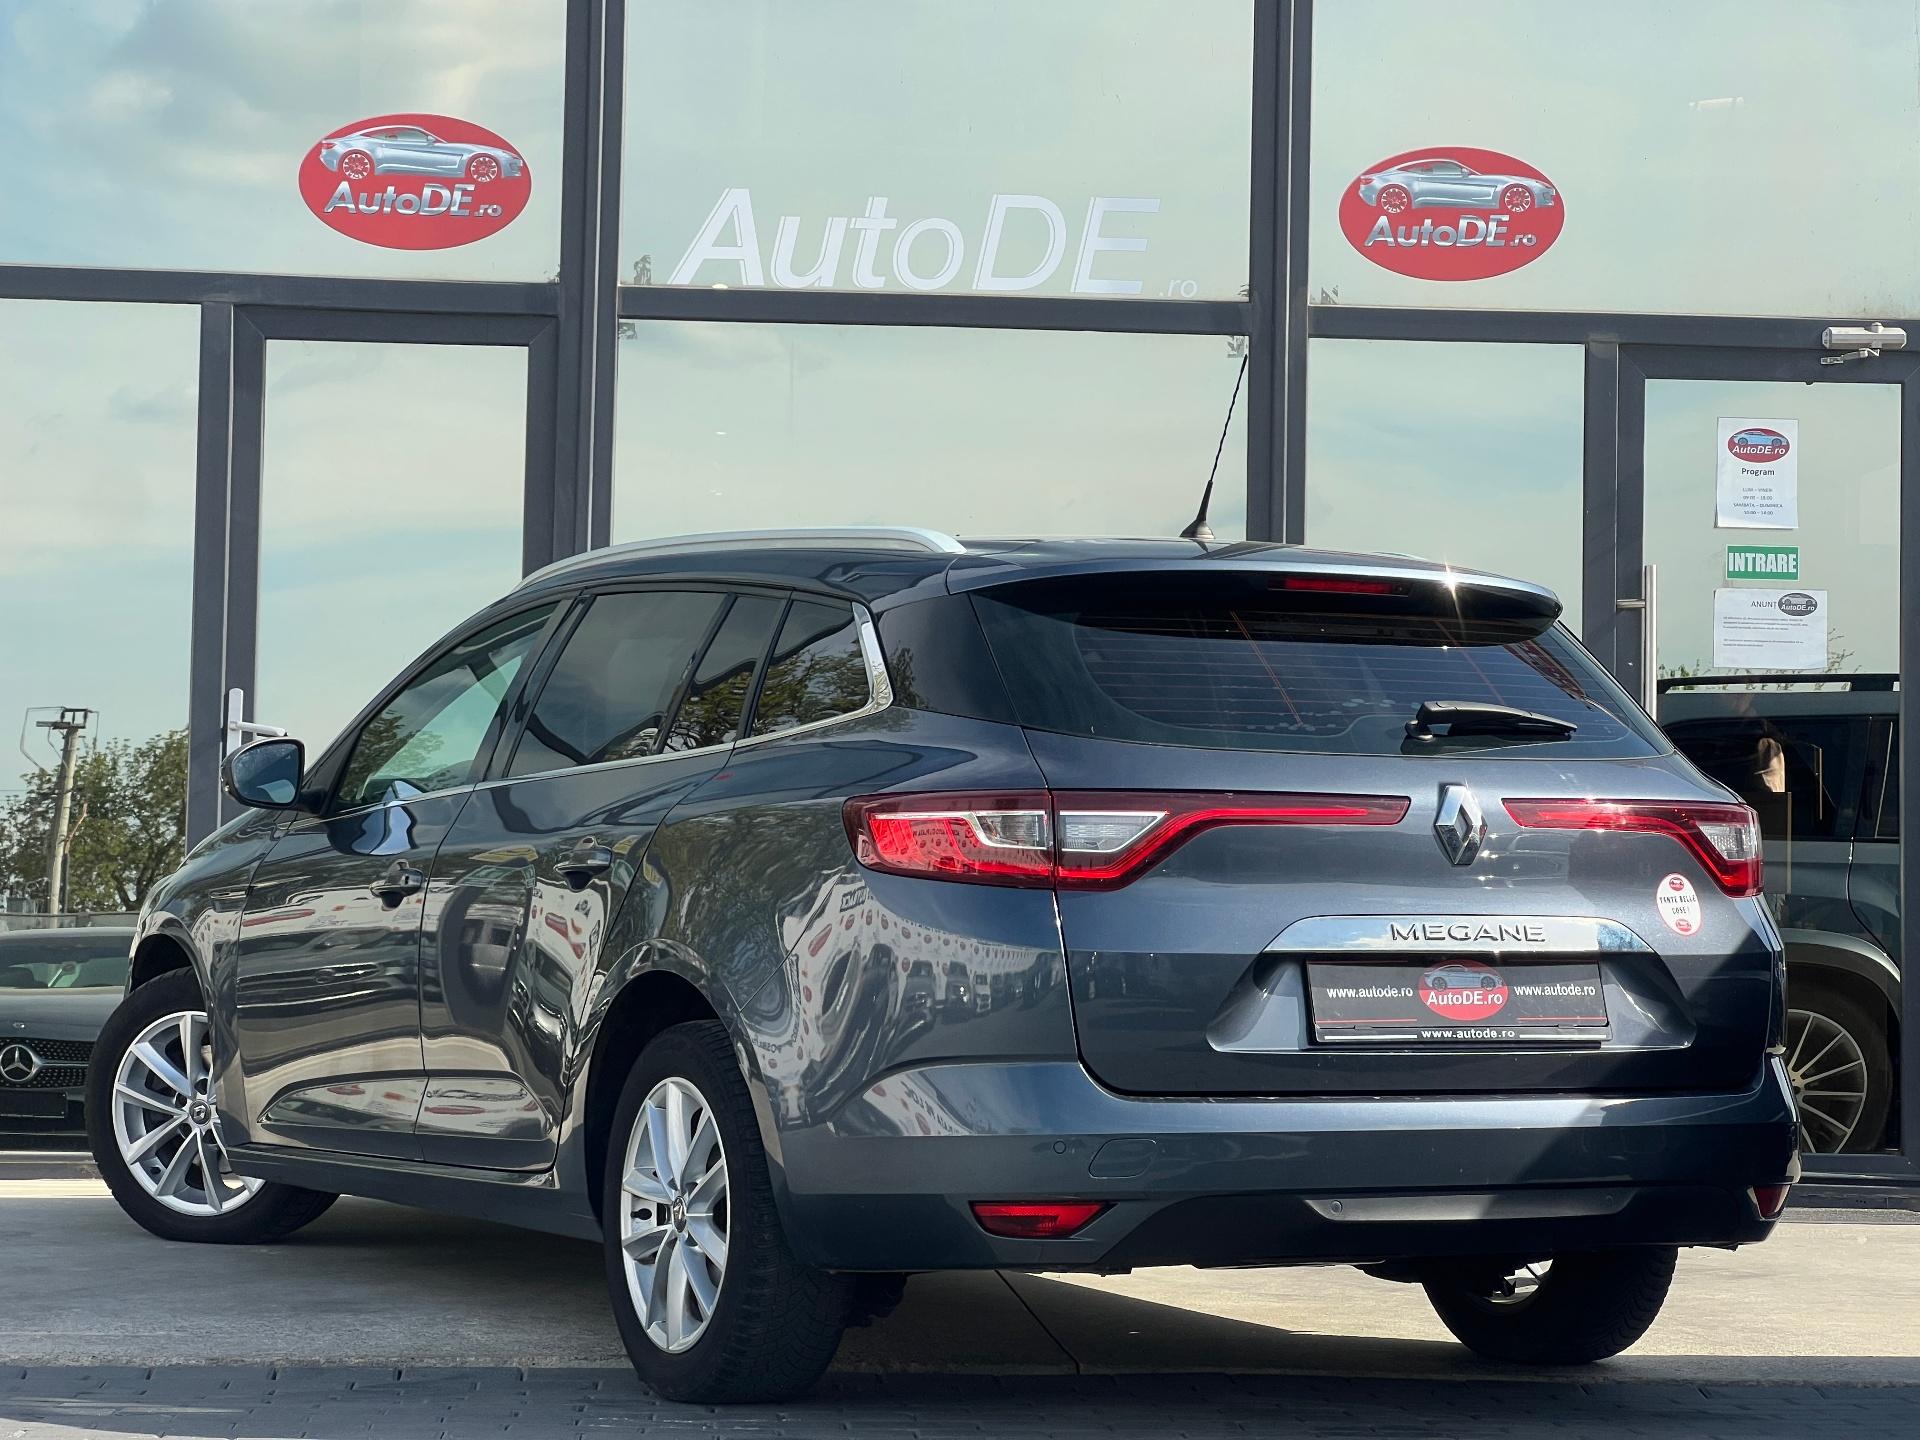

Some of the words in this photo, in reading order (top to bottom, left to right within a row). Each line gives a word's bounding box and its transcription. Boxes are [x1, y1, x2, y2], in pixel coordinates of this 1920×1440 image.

[1732, 445, 1786, 455] AutoDE.ro
[1741, 467, 1775, 477] Program
[1728, 552, 1797, 573] INTRARE
[1679, 894, 1697, 903] BELLE
[1390, 922, 1545, 943] MEGANE
[1326, 985, 1414, 999] www.autode.ro
[1513, 984, 1596, 997] www.autode.ro
[1426, 990, 1504, 1006] AutoDE.ro
[1420, 1028, 1516, 1039] www.autode.ro
